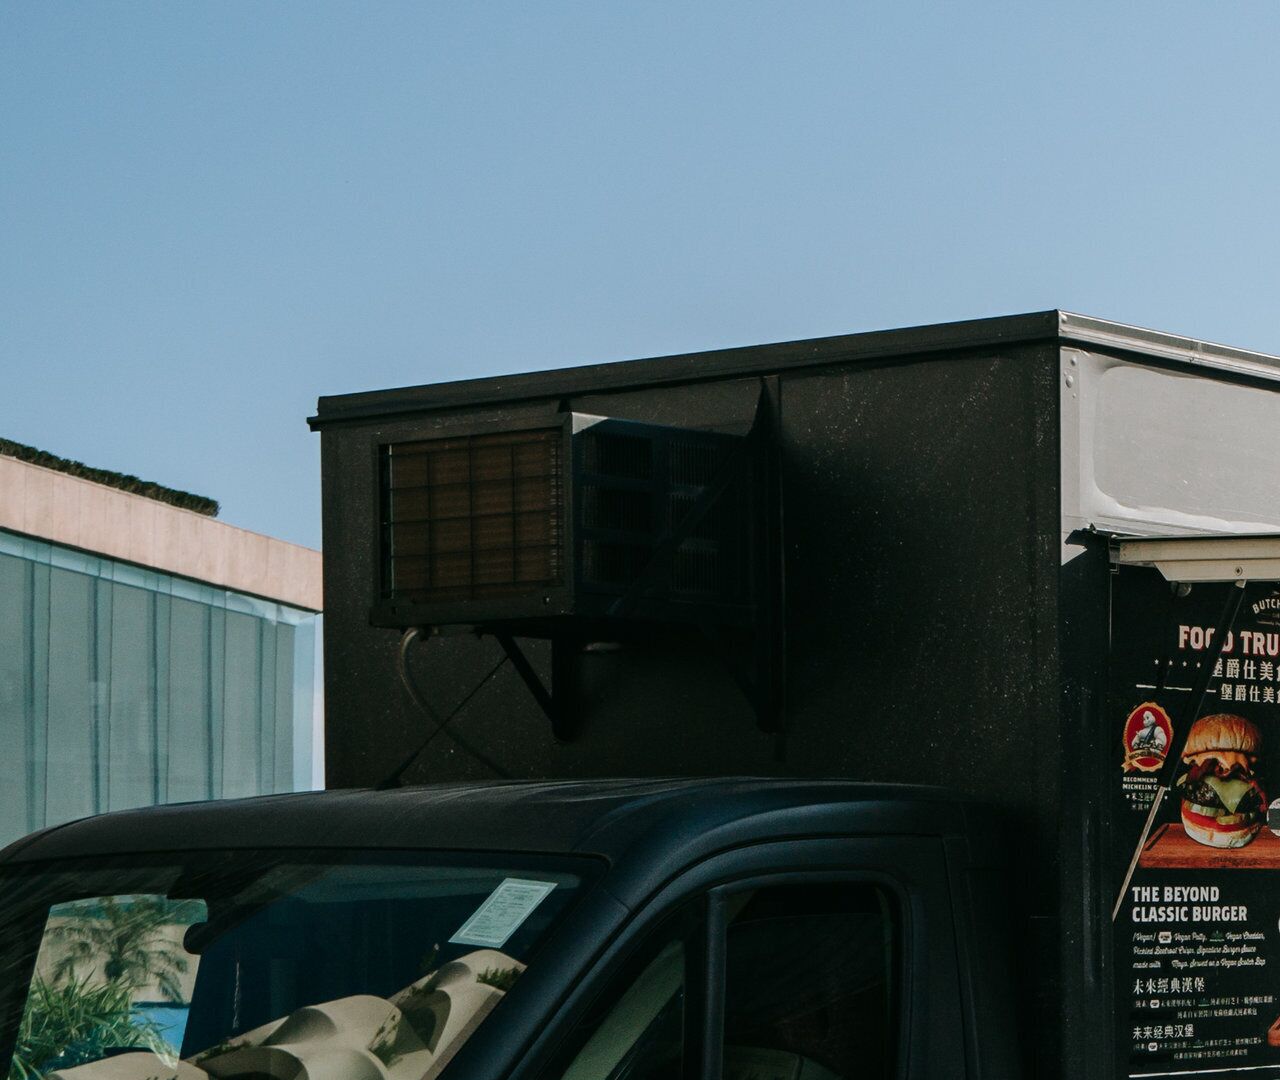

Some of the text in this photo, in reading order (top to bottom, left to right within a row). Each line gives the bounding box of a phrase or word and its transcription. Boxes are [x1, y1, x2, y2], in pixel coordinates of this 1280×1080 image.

[1132, 886, 1219, 902] THE BEYOND
[1132, 906, 1247, 922] CLASSIC BURGER
[1132, 977, 1205, 995] 未來經典漢堡
[1132, 1023, 1194, 1040] 未来经典汉堡
